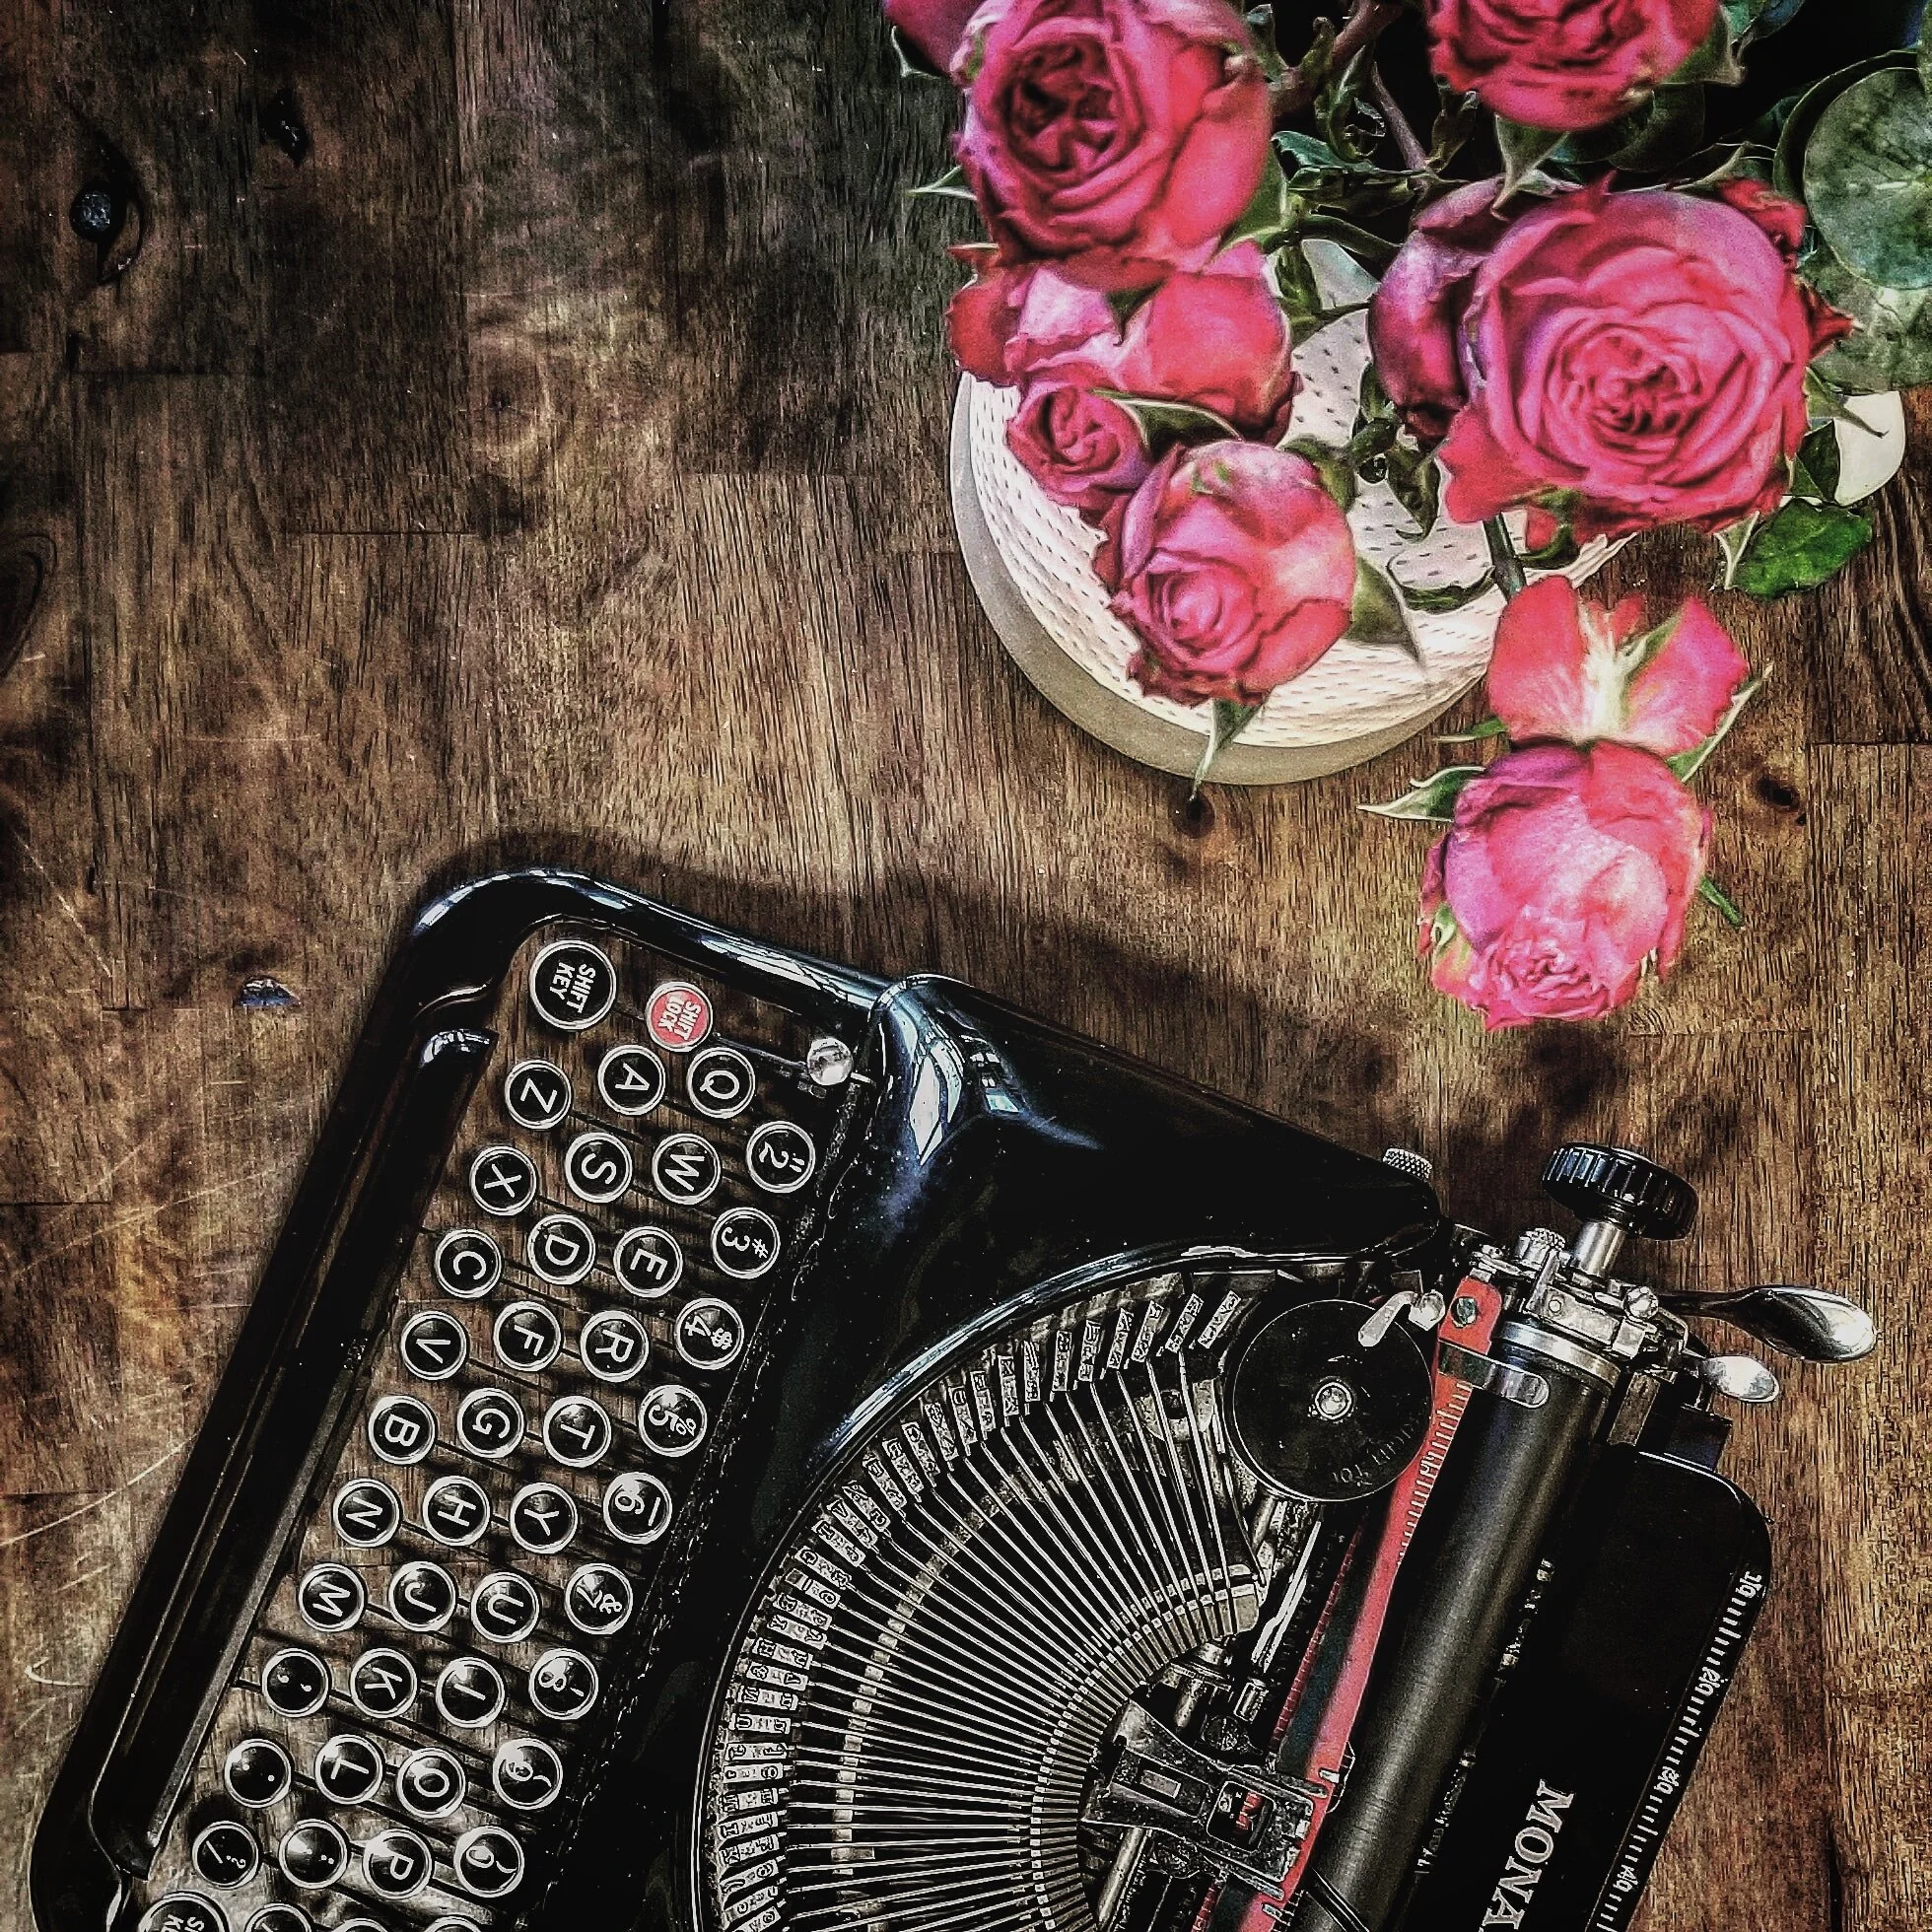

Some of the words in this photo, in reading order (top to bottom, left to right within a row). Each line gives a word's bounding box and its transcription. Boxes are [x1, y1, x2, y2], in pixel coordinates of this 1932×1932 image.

[550, 962, 575, 1000] KEY
[567, 964, 596, 1013] SHIFT
[658, 995, 684, 1032] LOCK
[674, 1001, 701, 1040] SHIFT
[614, 1063, 649, 1092] A
[699, 1070, 739, 1095] Q
[519, 1081, 557, 1114] Z
[483, 1163, 522, 1198] X
[581, 1153, 615, 1185] S
[664, 1153, 706, 1192] W
[453, 1251, 486, 1279] C
[546, 1236, 580, 1266] D
[631, 1248, 667, 1279] E
[416, 1339, 450, 1363] V
[514, 1325, 545, 1356] F
[594, 1329, 635, 1364] R
[384, 1414, 421, 1447] B
[472, 1410, 511, 1438] G
[561, 1420, 595, 1450] T
[346, 1496, 382, 1529] N
[438, 1501, 477, 1527] H
[524, 1508, 559, 1537] Y
[313, 1582, 351, 1619] M
[404, 1582, 437, 1614] J
[488, 1591, 522, 1624] U
[364, 1667, 402, 1699] K
[331, 1757, 369, 1779] L
[414, 1768, 449, 1797] O
[390, 1852, 414, 1880] P
[1479, 1778, 1575, 1932] MONA
